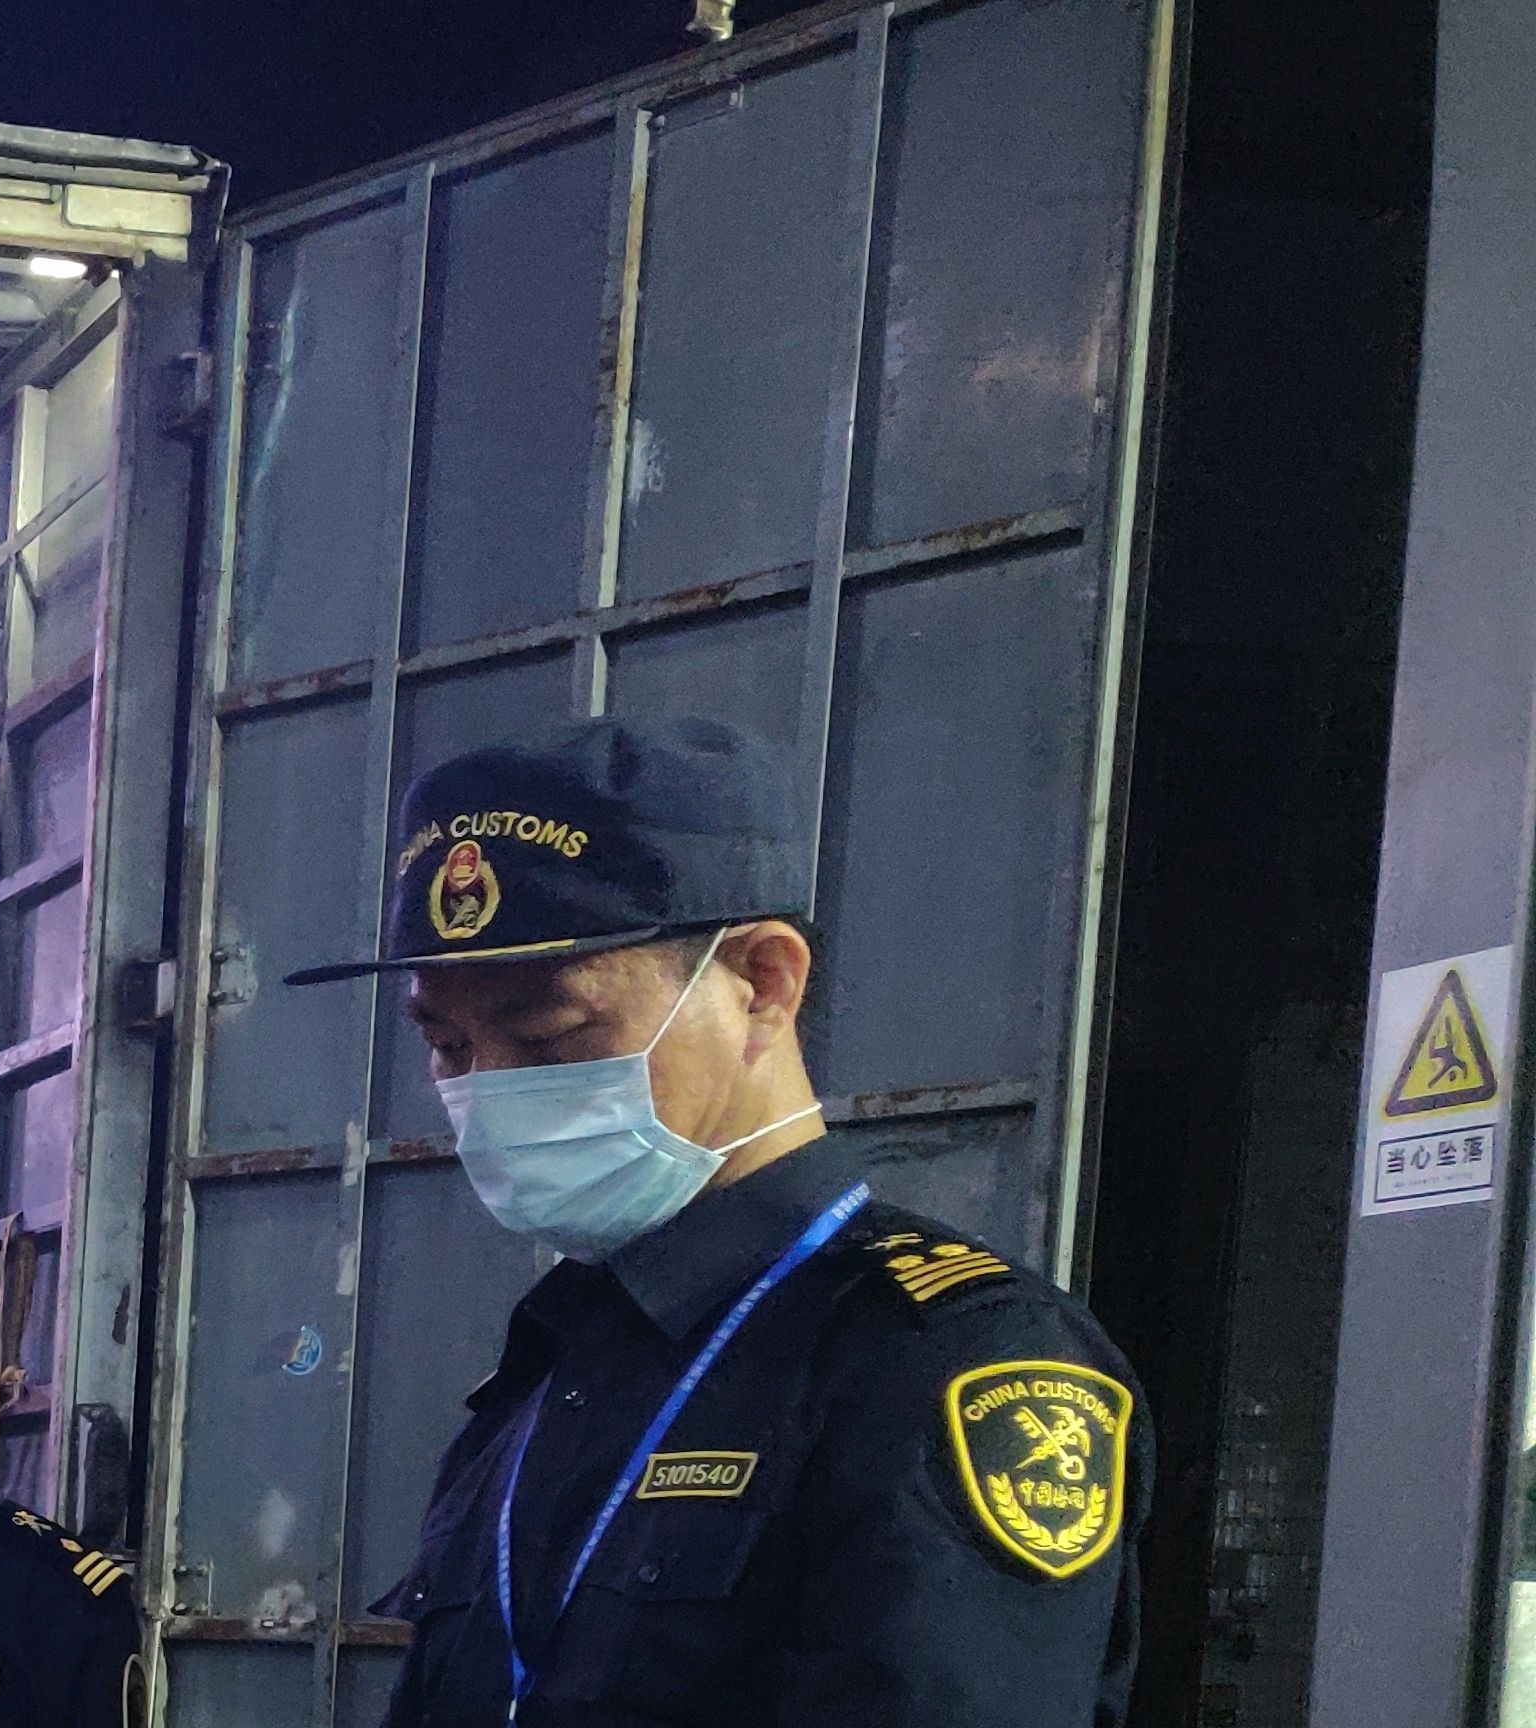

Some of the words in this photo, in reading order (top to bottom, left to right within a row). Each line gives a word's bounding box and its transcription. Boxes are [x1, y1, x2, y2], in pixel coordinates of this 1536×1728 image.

[450, 812, 588, 858] CUSTOMS
[963, 1381, 1030, 1421] CHINA
[1033, 1381, 1117, 1434] CUSTOMS
[652, 1464, 739, 1486] 5101540
